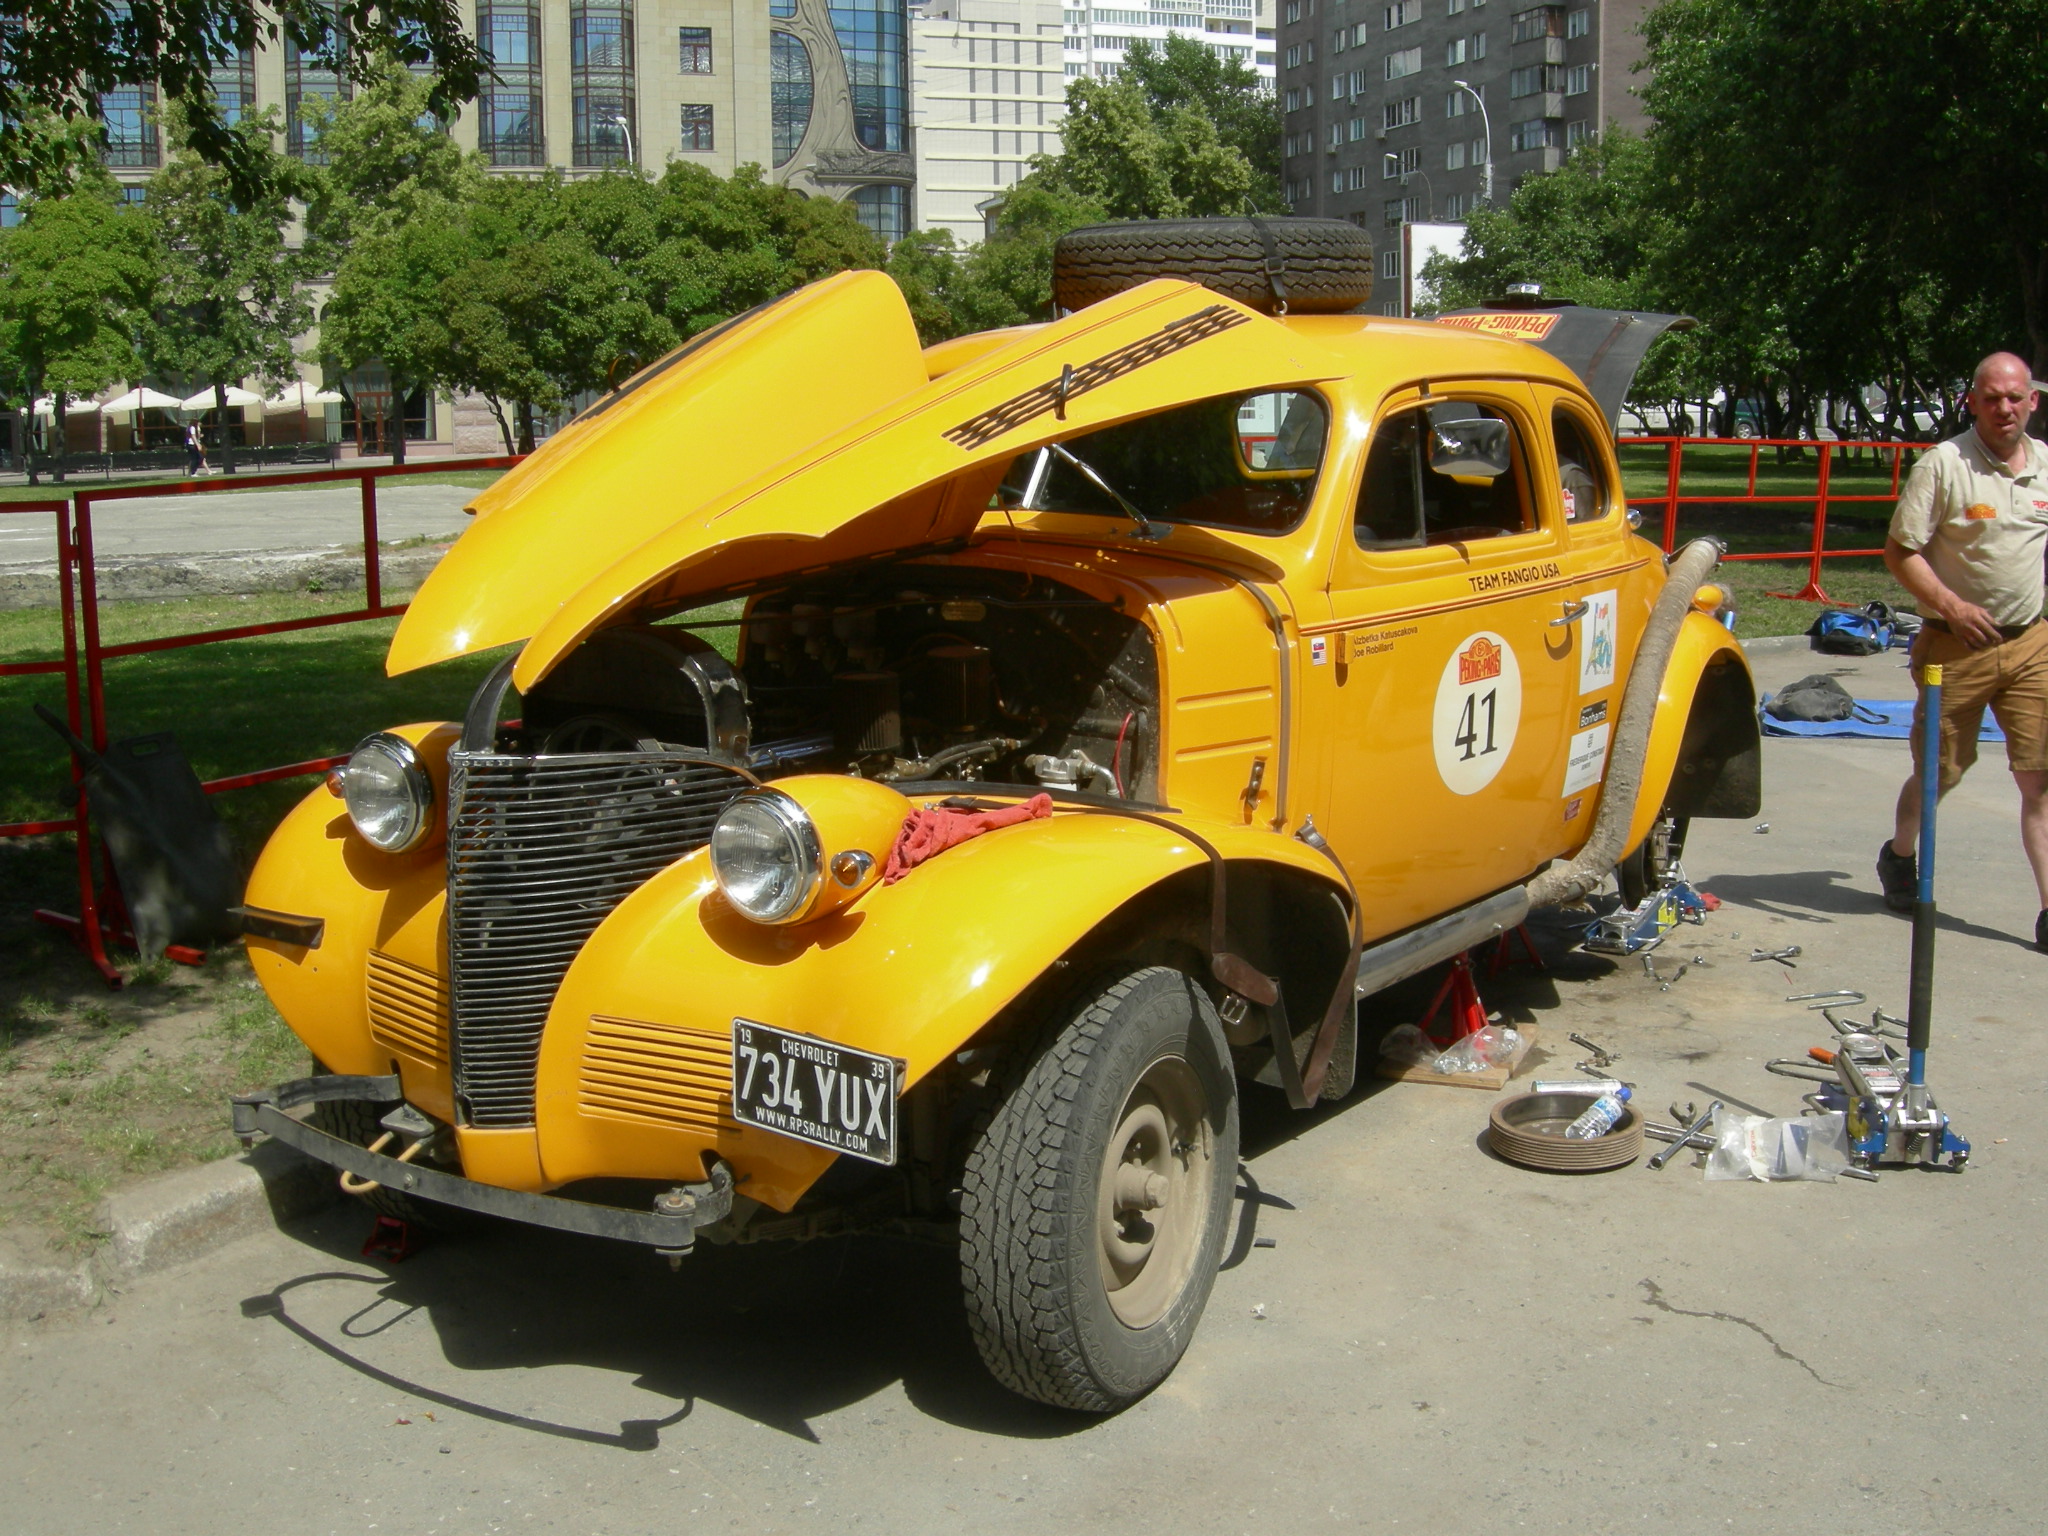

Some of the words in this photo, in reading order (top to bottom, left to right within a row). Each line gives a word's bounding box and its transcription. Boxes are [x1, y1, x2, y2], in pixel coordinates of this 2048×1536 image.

[1488, 316, 1553, 334] PEKING
[1469, 573, 1501, 592] TEAM
[1501, 566, 1539, 586] FANGIO
[1540, 562, 1561, 579] USA
[1461, 657, 1481, 680] PEKING
[1484, 650, 1500, 676] PARIS
[1455, 688, 1498, 762] 41
[1580, 710, 1606, 727] Bonhams
[740, 1027, 752, 1044] 19
[781, 1038, 839, 1068] CHEVROLET
[871, 1062, 885, 1079] 39
[739, 1045, 803, 1116] 734
[814, 1064, 887, 1141] YUX
[755, 1105, 868, 1153] WWW.RPSRALLY.COM
